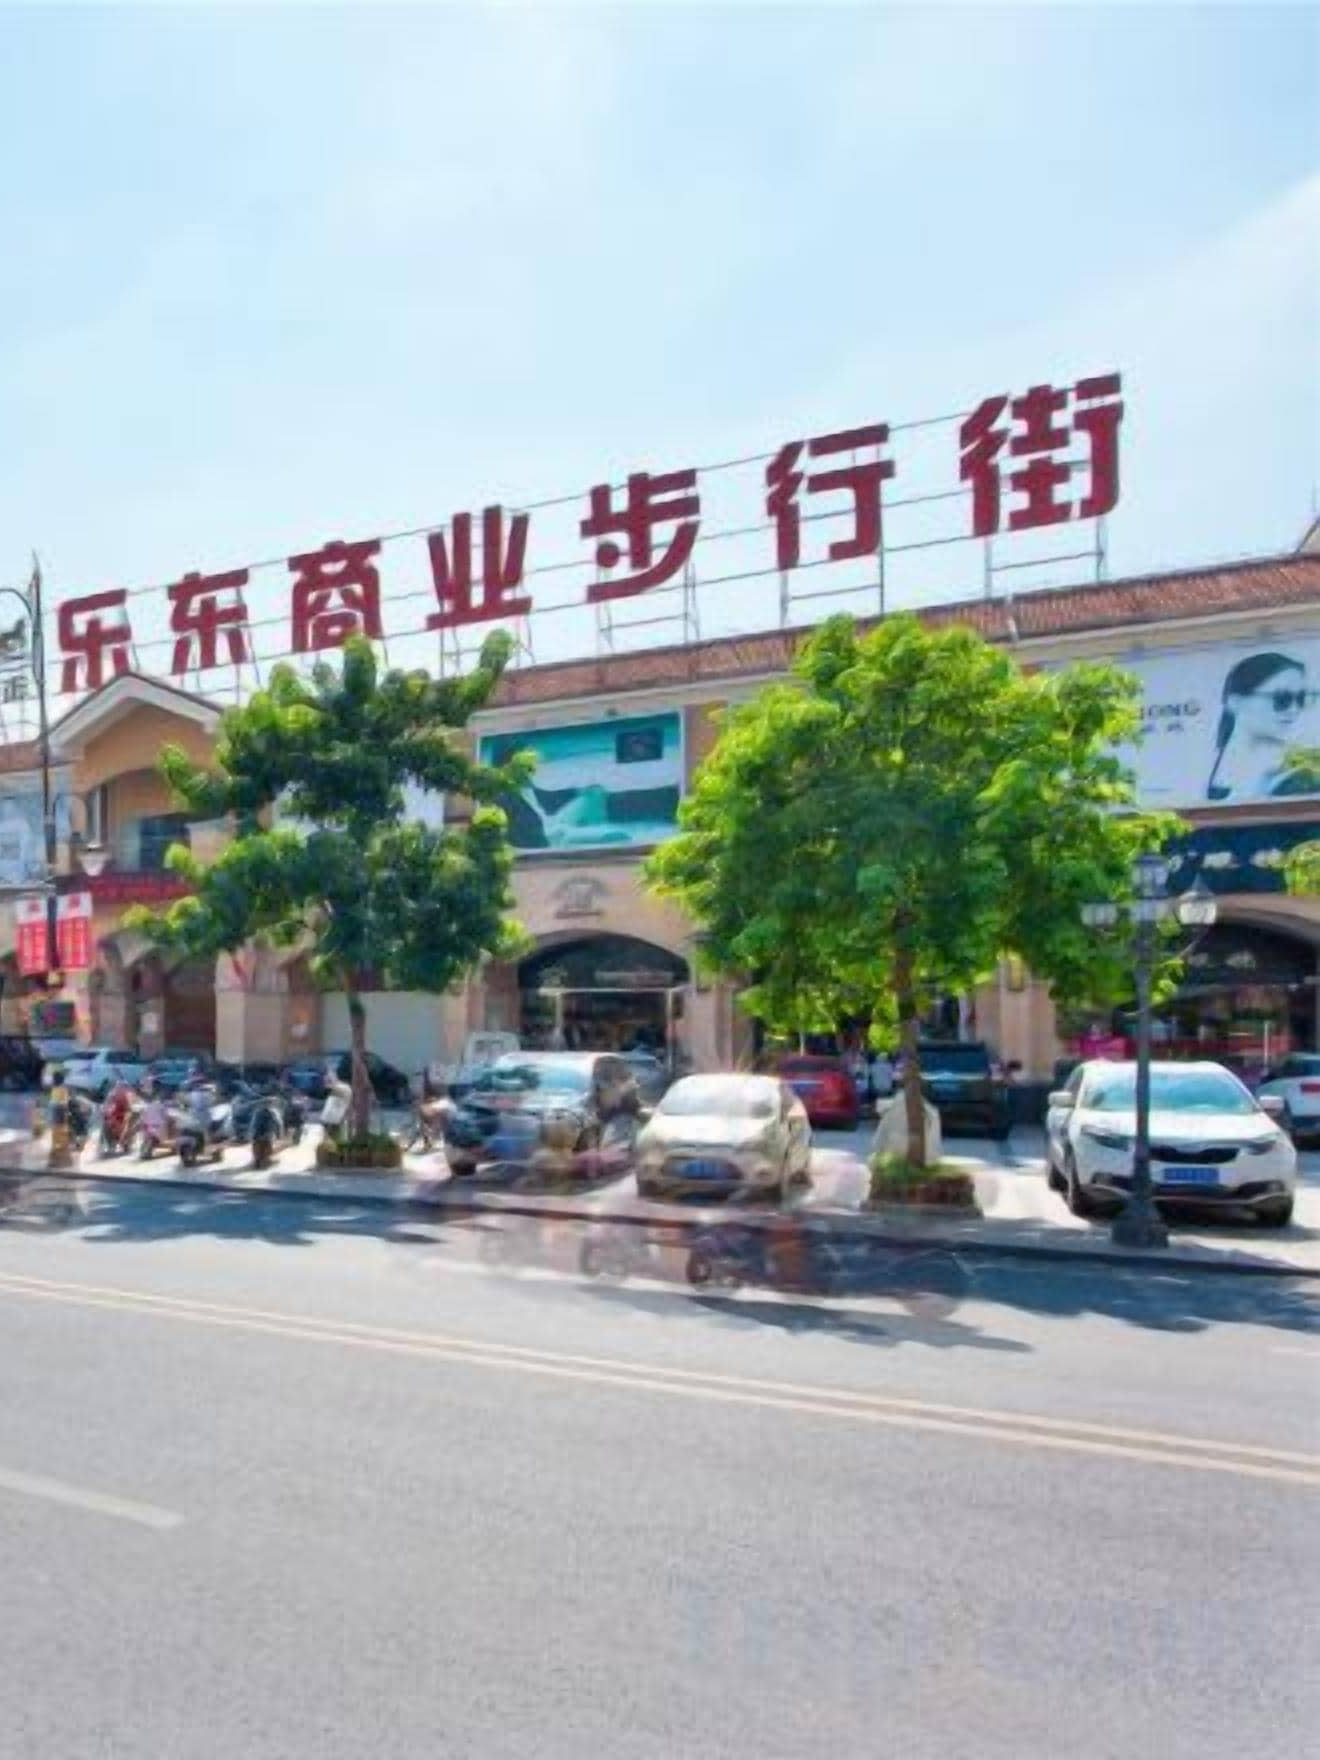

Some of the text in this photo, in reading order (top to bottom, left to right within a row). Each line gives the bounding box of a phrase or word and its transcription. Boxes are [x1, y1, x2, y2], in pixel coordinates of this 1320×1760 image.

[57, 372, 1123, 693] 乐东商业步行街
